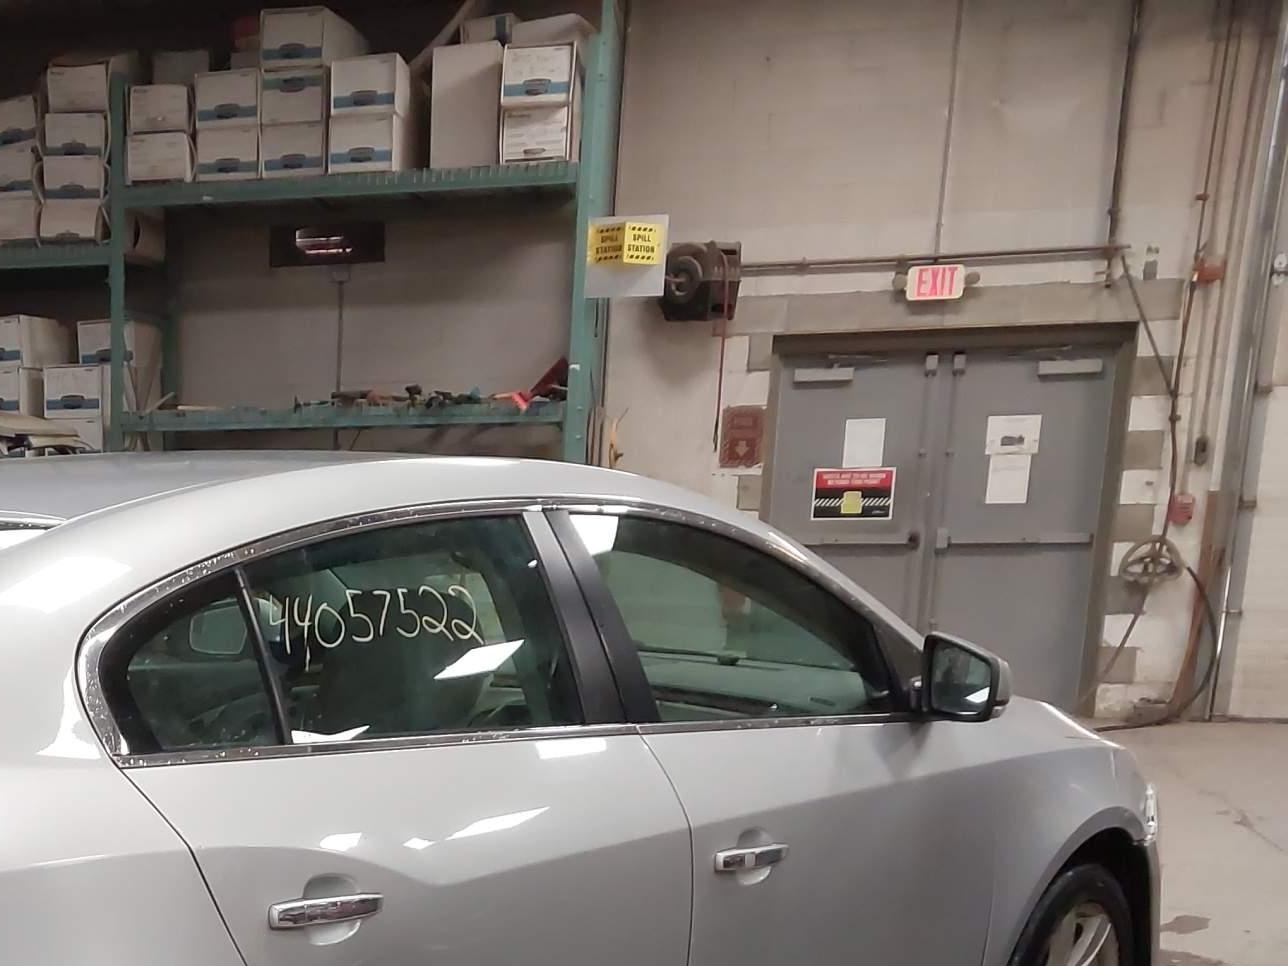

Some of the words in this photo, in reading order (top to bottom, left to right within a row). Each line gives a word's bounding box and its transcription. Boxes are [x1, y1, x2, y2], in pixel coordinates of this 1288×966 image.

[633, 234, 651, 242] SPILL
[627, 244, 655, 253] STATION
[917, 267, 958, 297] EXIT
[269, 585, 485, 671] 44057522
